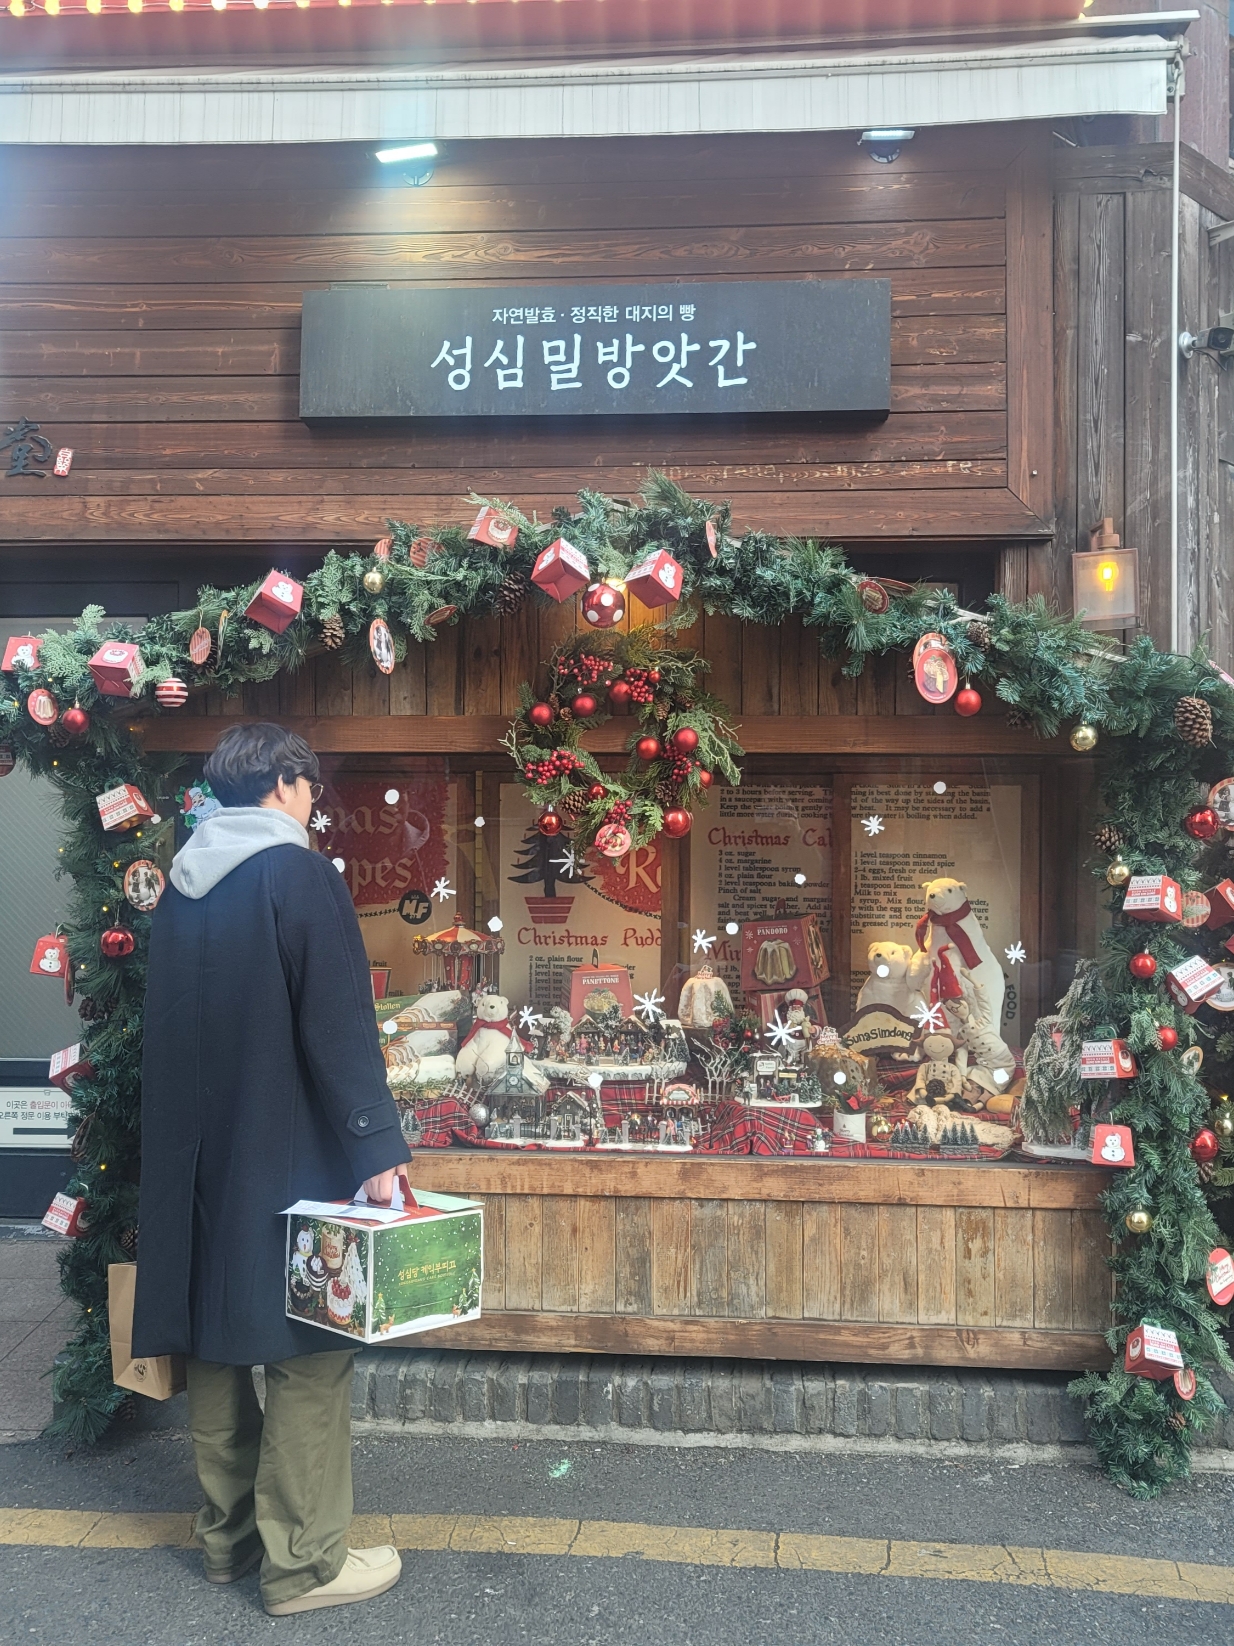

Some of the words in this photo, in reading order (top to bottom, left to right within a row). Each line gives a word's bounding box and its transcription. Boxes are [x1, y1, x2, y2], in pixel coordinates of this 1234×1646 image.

[492, 306, 556, 325] 자연발효
[570, 305, 619, 323] 정직한
[626, 304, 673, 322] 대지의
[680, 304, 696, 322] 빵
[742, 788, 762, 796] hours
[914, 790, 923, 798] by
[886, 798, 898, 806] way
[720, 803, 738, 811] Keep
[801, 804, 823, 813] gently
[922, 806, 956, 814] necessary
[720, 810, 736, 818] little
[800, 812, 828, 821] cooking
[906, 812, 930, 821] boiling
[932, 812, 951, 820] when
[708, 826, 790, 847] Christmas
[879, 852, 910, 860] teaspoon
[912, 852, 947, 860] cinnamon
[737, 857, 772, 866] margarine
[879, 860, 910, 868] teaspoon
[936, 860, 955, 868] spice
[738, 872, 754, 880] plain
[743, 880, 776, 888] teaspoons
[804, 880, 830, 889] powder
[894, 882, 916, 890] lemon
[860, 898, 882, 906] syrup.
[906, 898, 926, 906] flour,
[890, 906, 902, 914] egg
[851, 912, 886, 920] substitute
[862, 920, 888, 928] greased
[757, 927, 788, 936] PANDORO
[518, 927, 608, 947] Christmas
[548, 955, 564, 964] plain
[535, 962, 550, 970] level
[582, 977, 620, 985] PANETTONE
[374, 1002, 400, 1011] Stollen
[6, 1100, 28, 1109] 이곳은
[30, 1100, 58, 1109] 출입문이
[20, 1112, 34, 1120] 정문
[37, 1112, 51, 1120] 이용
[398, 1266, 420, 1280] 성심당
